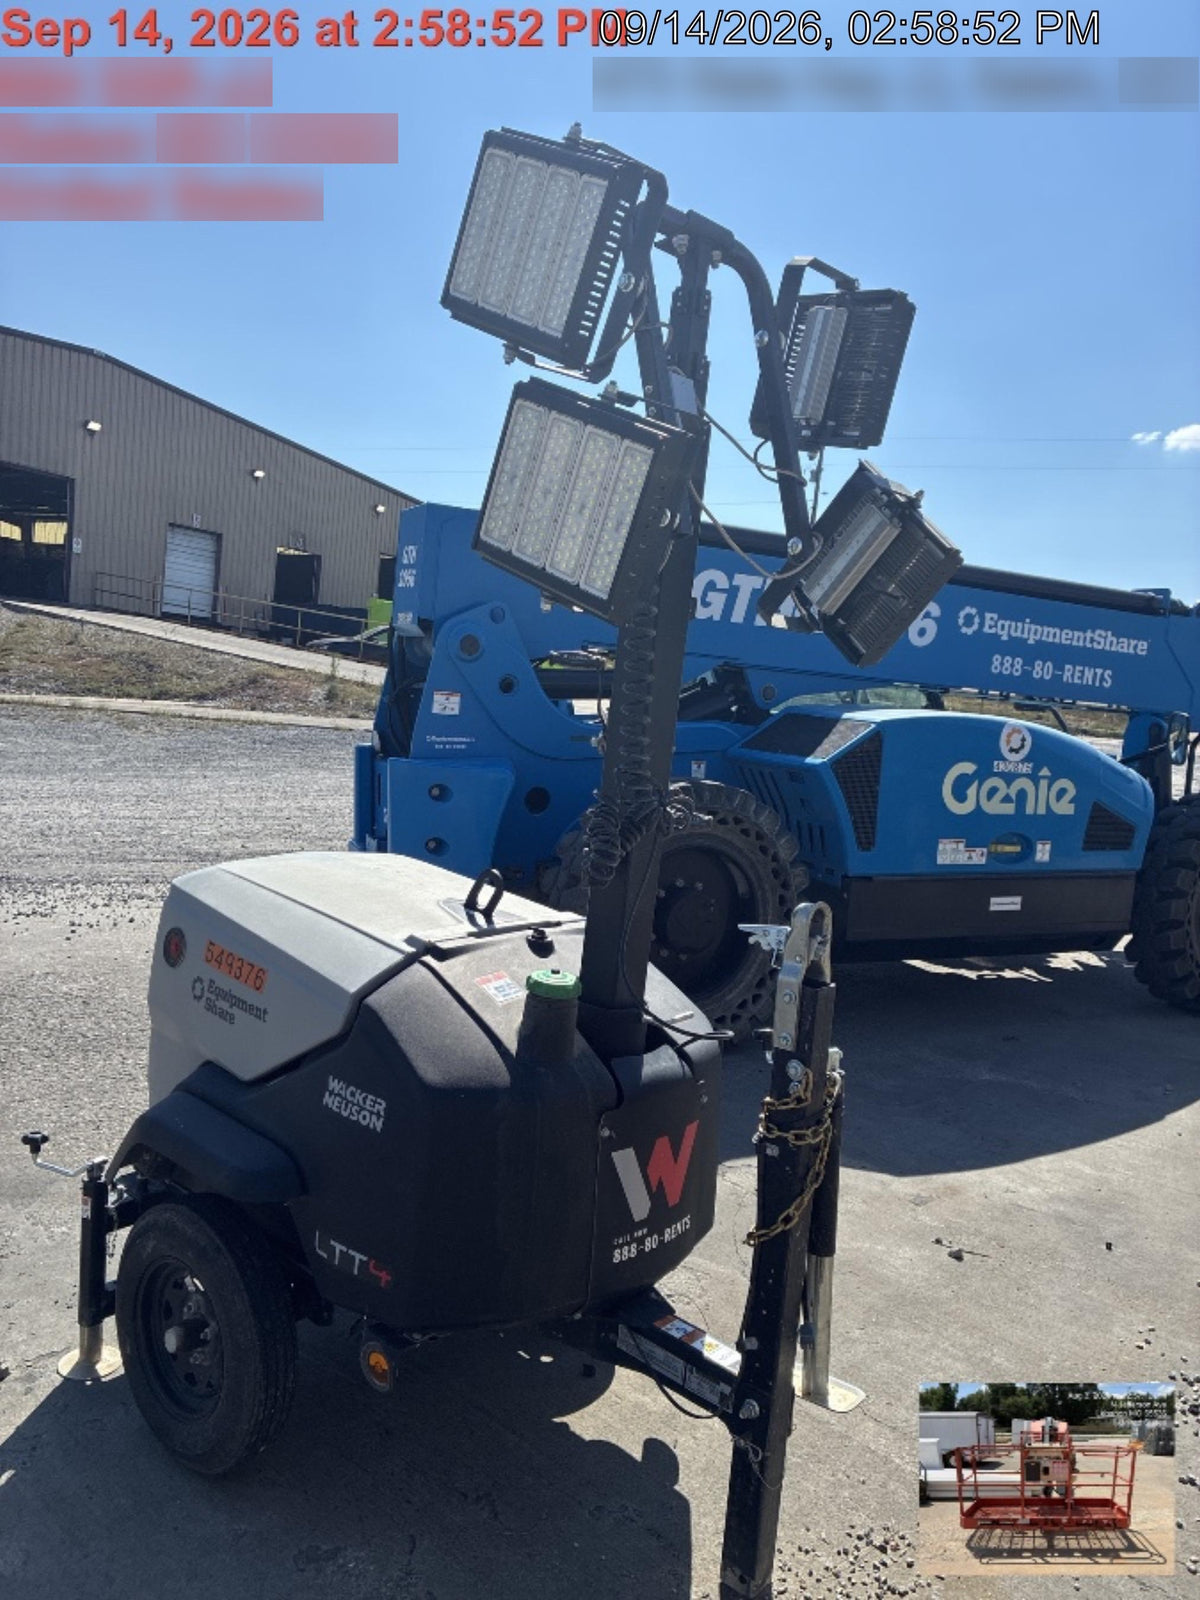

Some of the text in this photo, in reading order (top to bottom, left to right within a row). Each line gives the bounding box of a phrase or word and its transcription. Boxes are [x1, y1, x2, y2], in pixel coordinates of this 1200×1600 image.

[982, 611, 1149, 656] EquipmentShare
[991, 654, 1113, 689] 888-80-RENTS
[205, 941, 265, 991] 549376
[204, 996, 236, 1025] Share
[207, 978, 269, 1023] Equipment
[323, 1091, 385, 1134] NEUSON
[328, 1074, 387, 1118] WACKER
[315, 1229, 392, 1289] LTT4
[612, 1213, 692, 1263] 888-80-RENTS
